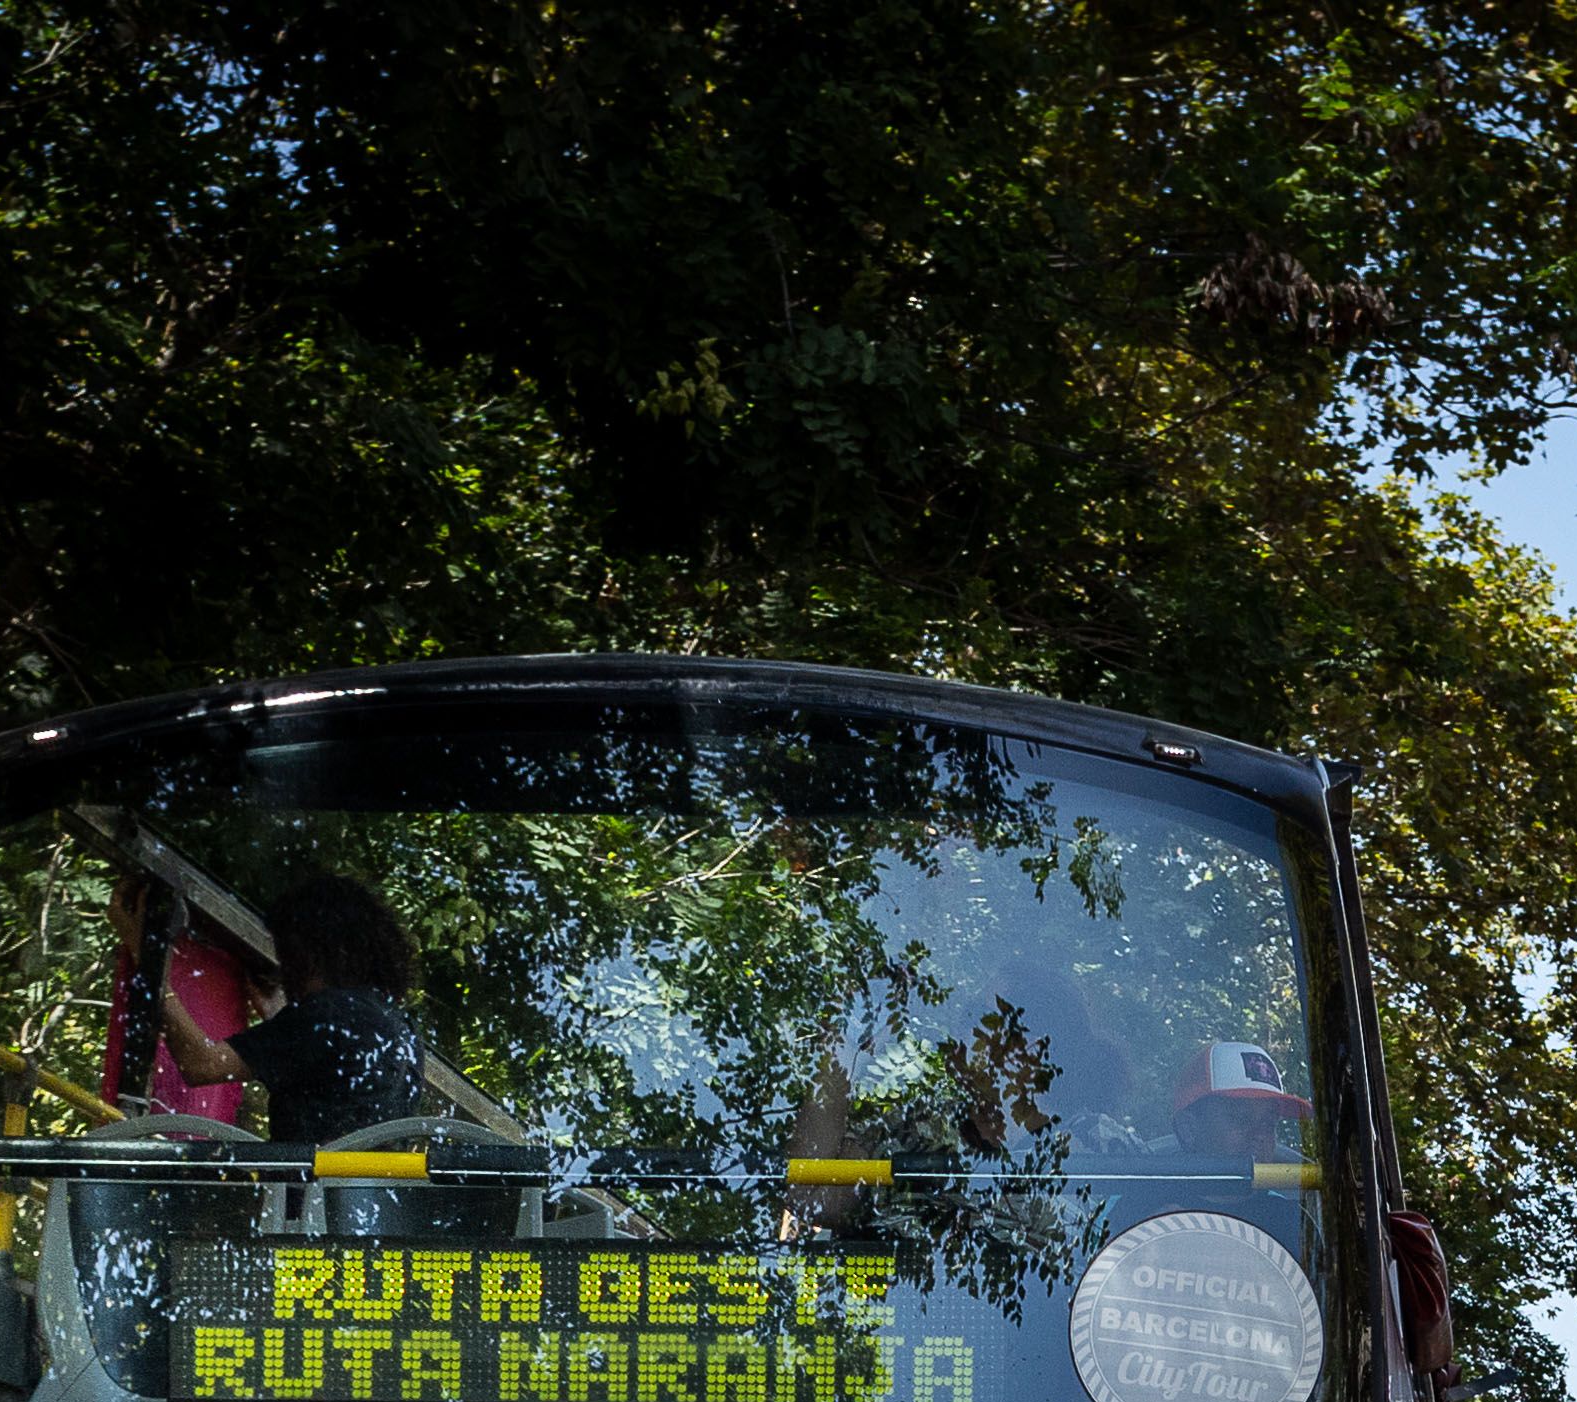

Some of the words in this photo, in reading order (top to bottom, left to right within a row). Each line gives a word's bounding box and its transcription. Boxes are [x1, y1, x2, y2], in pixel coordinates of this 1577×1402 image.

[273, 1248, 542, 1322] RUTA
[1132, 1265, 1275, 1307] OFFICIAL
[1099, 1306, 1294, 1356] BARCELONA
[193, 1326, 462, 1401] RUTA
